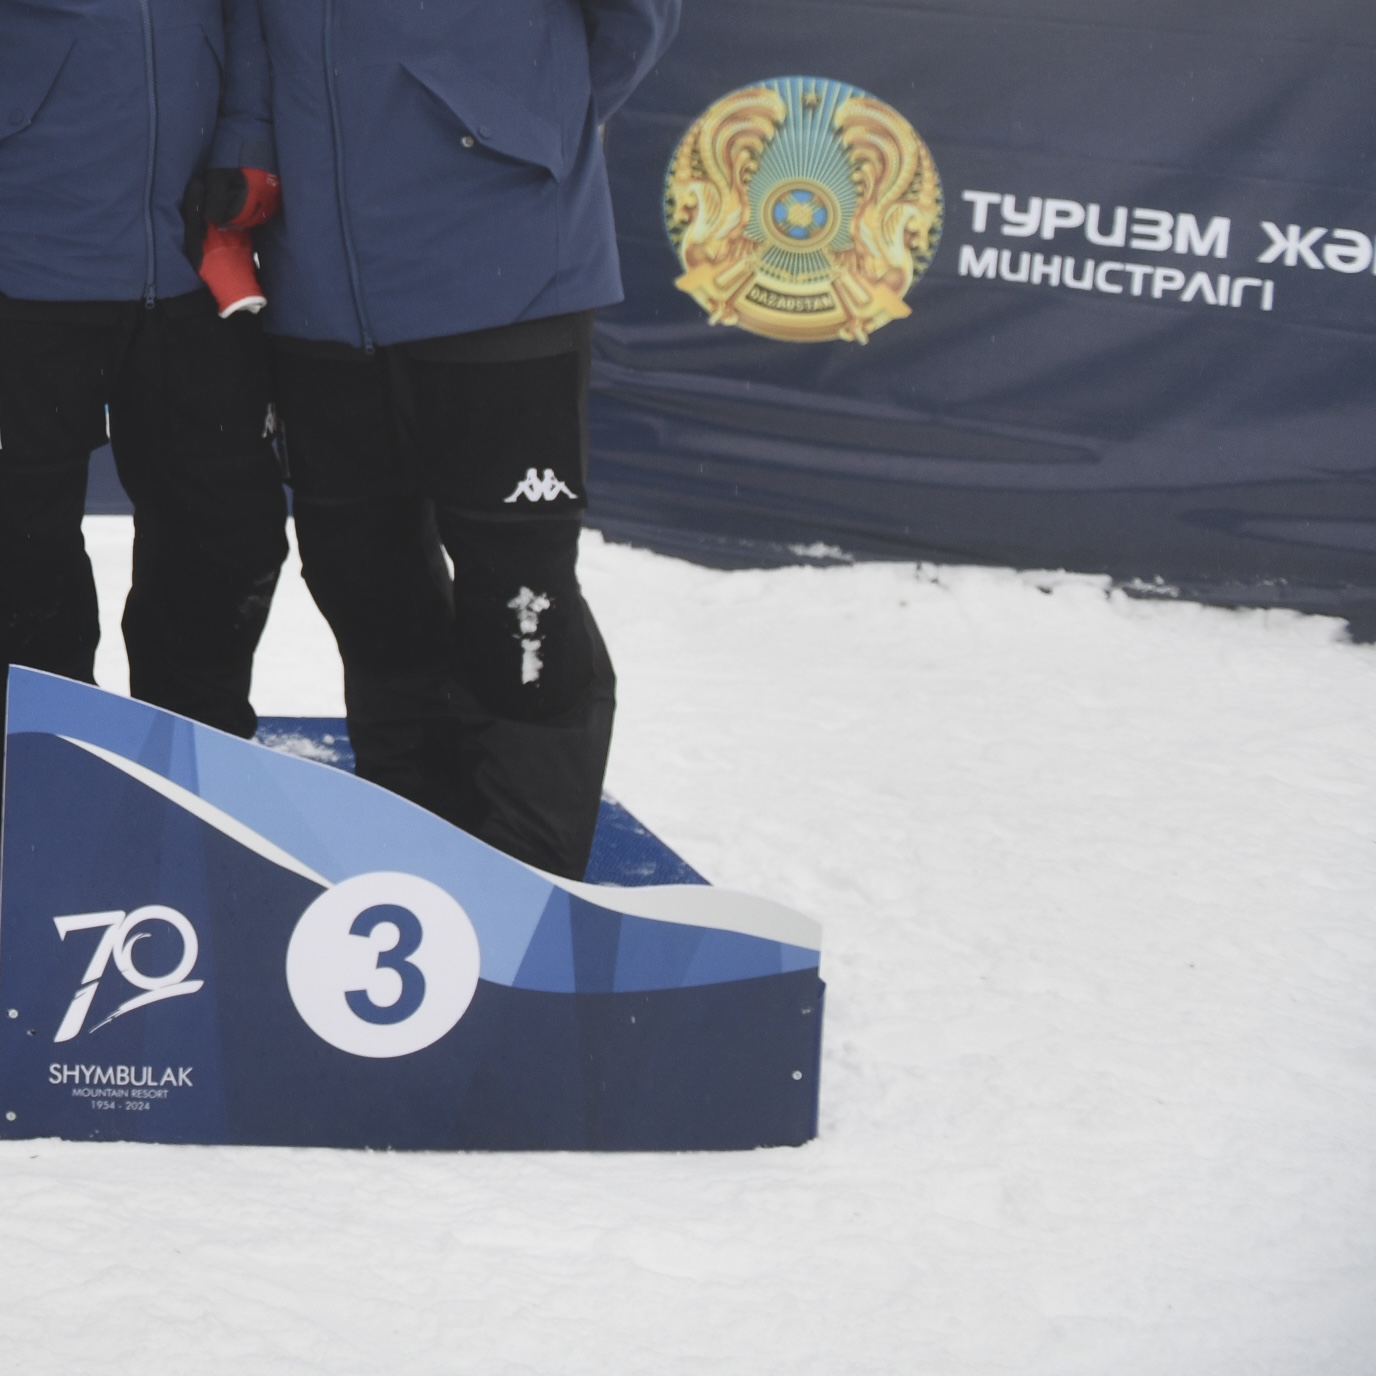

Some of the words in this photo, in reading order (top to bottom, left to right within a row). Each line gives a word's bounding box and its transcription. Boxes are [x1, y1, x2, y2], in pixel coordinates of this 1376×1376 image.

[961, 190, 1231, 259] ТУРИЗМ
[1258, 221, 1376, 275] ЖӘ
[344, 903, 426, 1026] 3
[49, 1062, 193, 1087] SHYMBULAK
[72, 1088, 128, 1098] MOUNTAIN
[132, 1089, 169, 1099] RESORT
[91, 1100, 115, 1110] 1954
[125, 1100, 151, 1111] 2024
